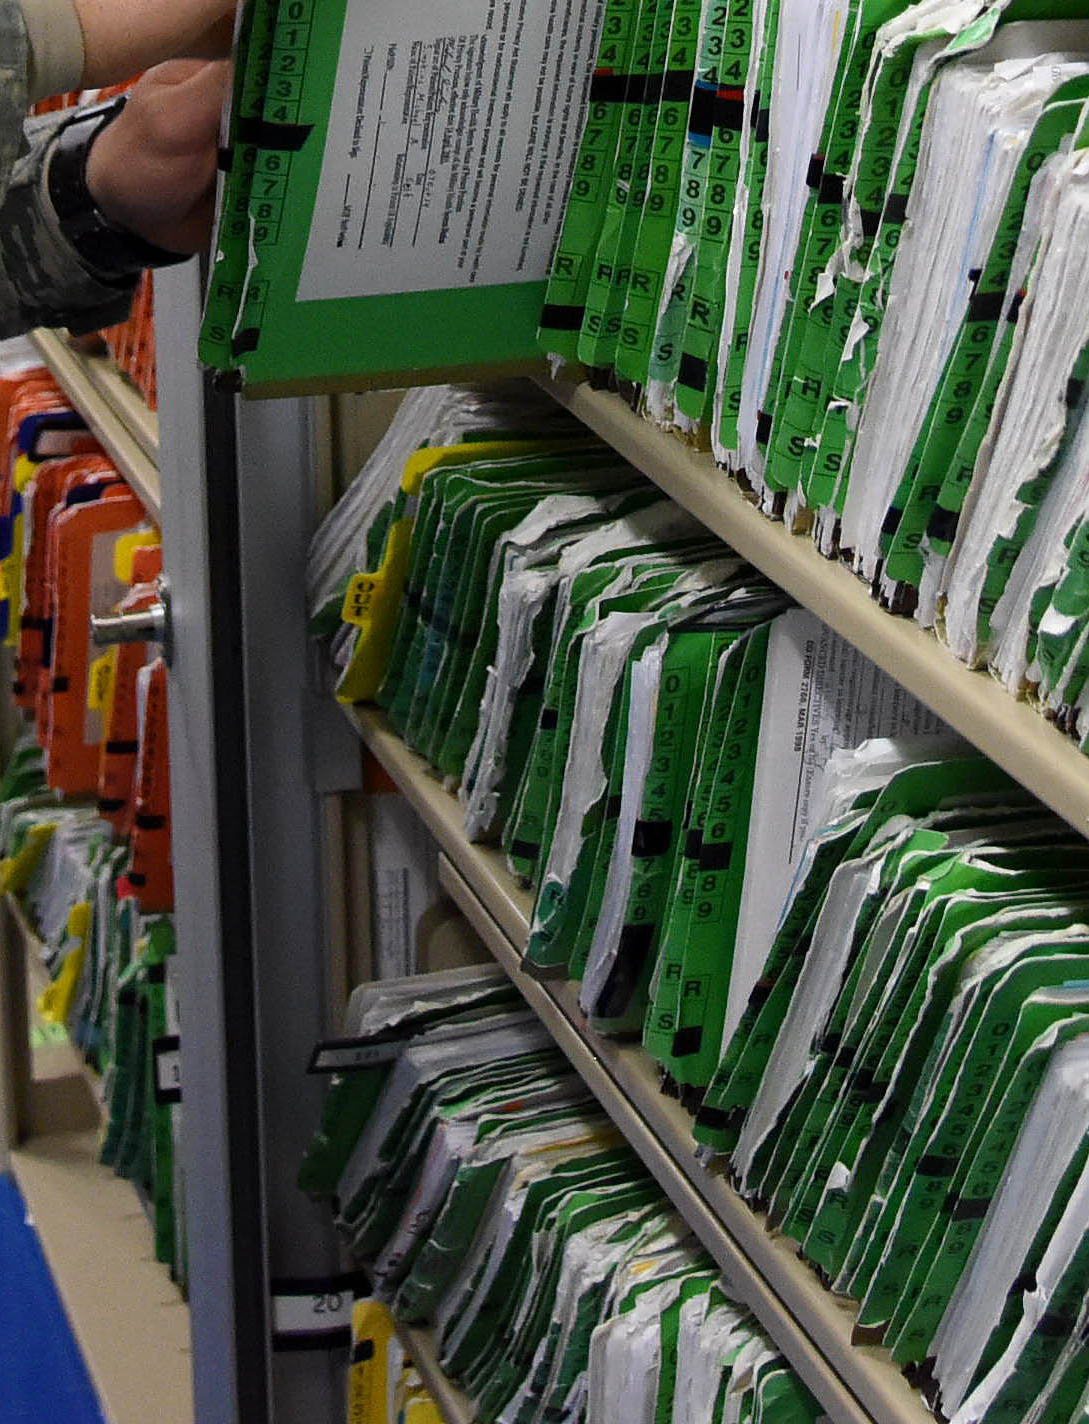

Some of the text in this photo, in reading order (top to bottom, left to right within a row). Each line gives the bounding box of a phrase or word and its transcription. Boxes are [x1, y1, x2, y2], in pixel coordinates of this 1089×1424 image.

[607, 16, 621, 34] 3
[677, 16, 691, 36] 3
[731, 29, 745, 48] 3
[664, 108, 679, 126] 6
[659, 136, 674, 154] 7
[581, 154, 595, 170] 8
[655, 165, 668, 184] 8
[575, 180, 590, 196] 9
[683, 150, 705, 227] 7 8 9
[711, 184, 725, 204] 8
[707, 216, 721, 235] 9
[555, 256, 573, 275] R
[632, 272, 651, 292] R
[622, 328, 639, 344] S
[312, 1293, 344, 1313] 20
